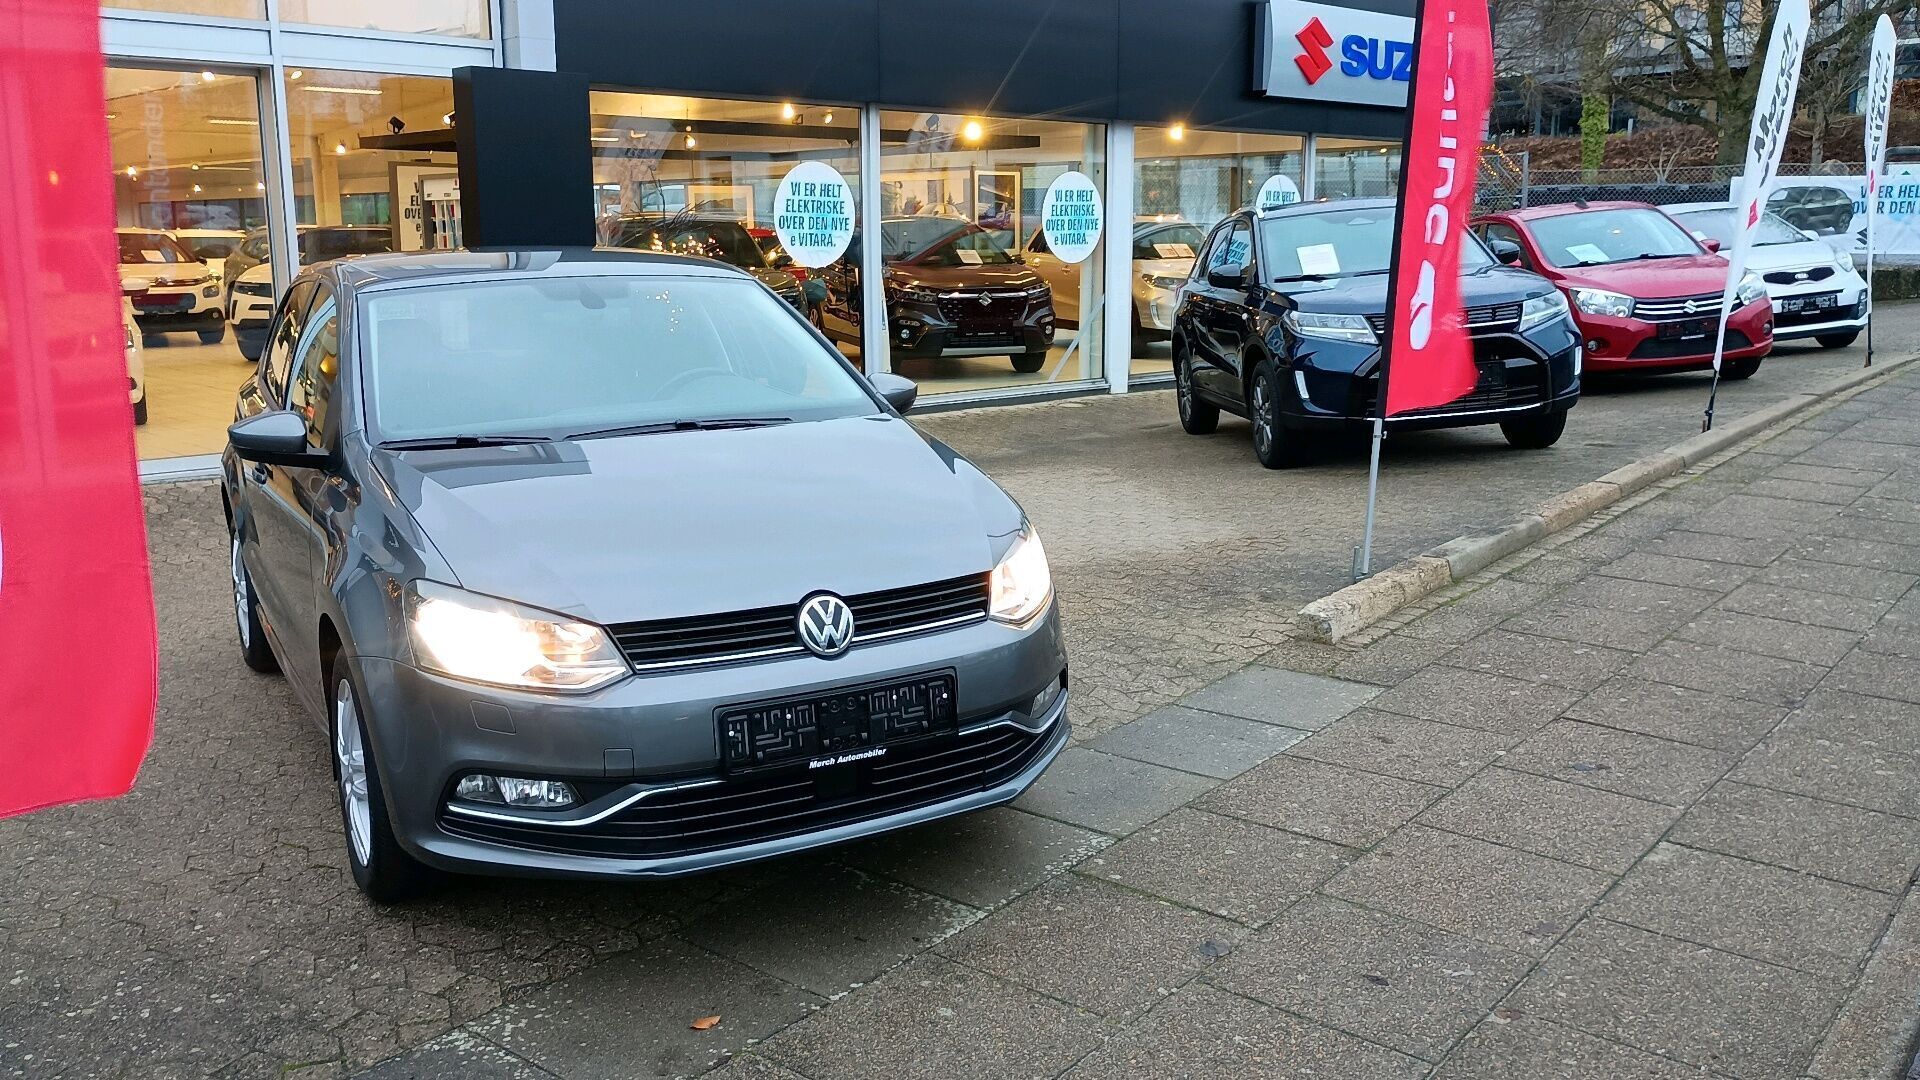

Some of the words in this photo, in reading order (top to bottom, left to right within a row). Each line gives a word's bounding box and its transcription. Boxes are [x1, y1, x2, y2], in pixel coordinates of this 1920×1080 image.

[790, 182, 801, 196] VI
[804, 182, 816, 197] ER
[819, 183, 843, 198] HELT
[1055, 189, 1063, 202] VI
[1064, 189, 1074, 202] ER
[1076, 189, 1094, 202] HELT
[1265, 190, 1273, 202] VI
[1272, 190, 1281, 202] ER
[1878, 185, 1894, 199] ER
[785, 198, 845, 214] ELEKTRISKE
[1051, 204, 1095, 217] ELEKTRISKE
[1852, 200, 1885, 214] OVR
[1889, 200, 1916, 214] DEN
[778, 215, 805, 230] OVER
[808, 216, 828, 231] DEN
[831, 217, 850, 231] NYE
[1045, 219, 1065, 231] OVER
[1067, 218, 1083, 231] DEN
[1084, 218, 1099, 231] NYE
[790, 235, 796, 246] e
[798, 232, 836, 247] VITARA.
[1054, 236, 1059, 245] e
[1060, 232, 1089, 245] VITARA.
[836, 748, 887, 764] Automobiler
